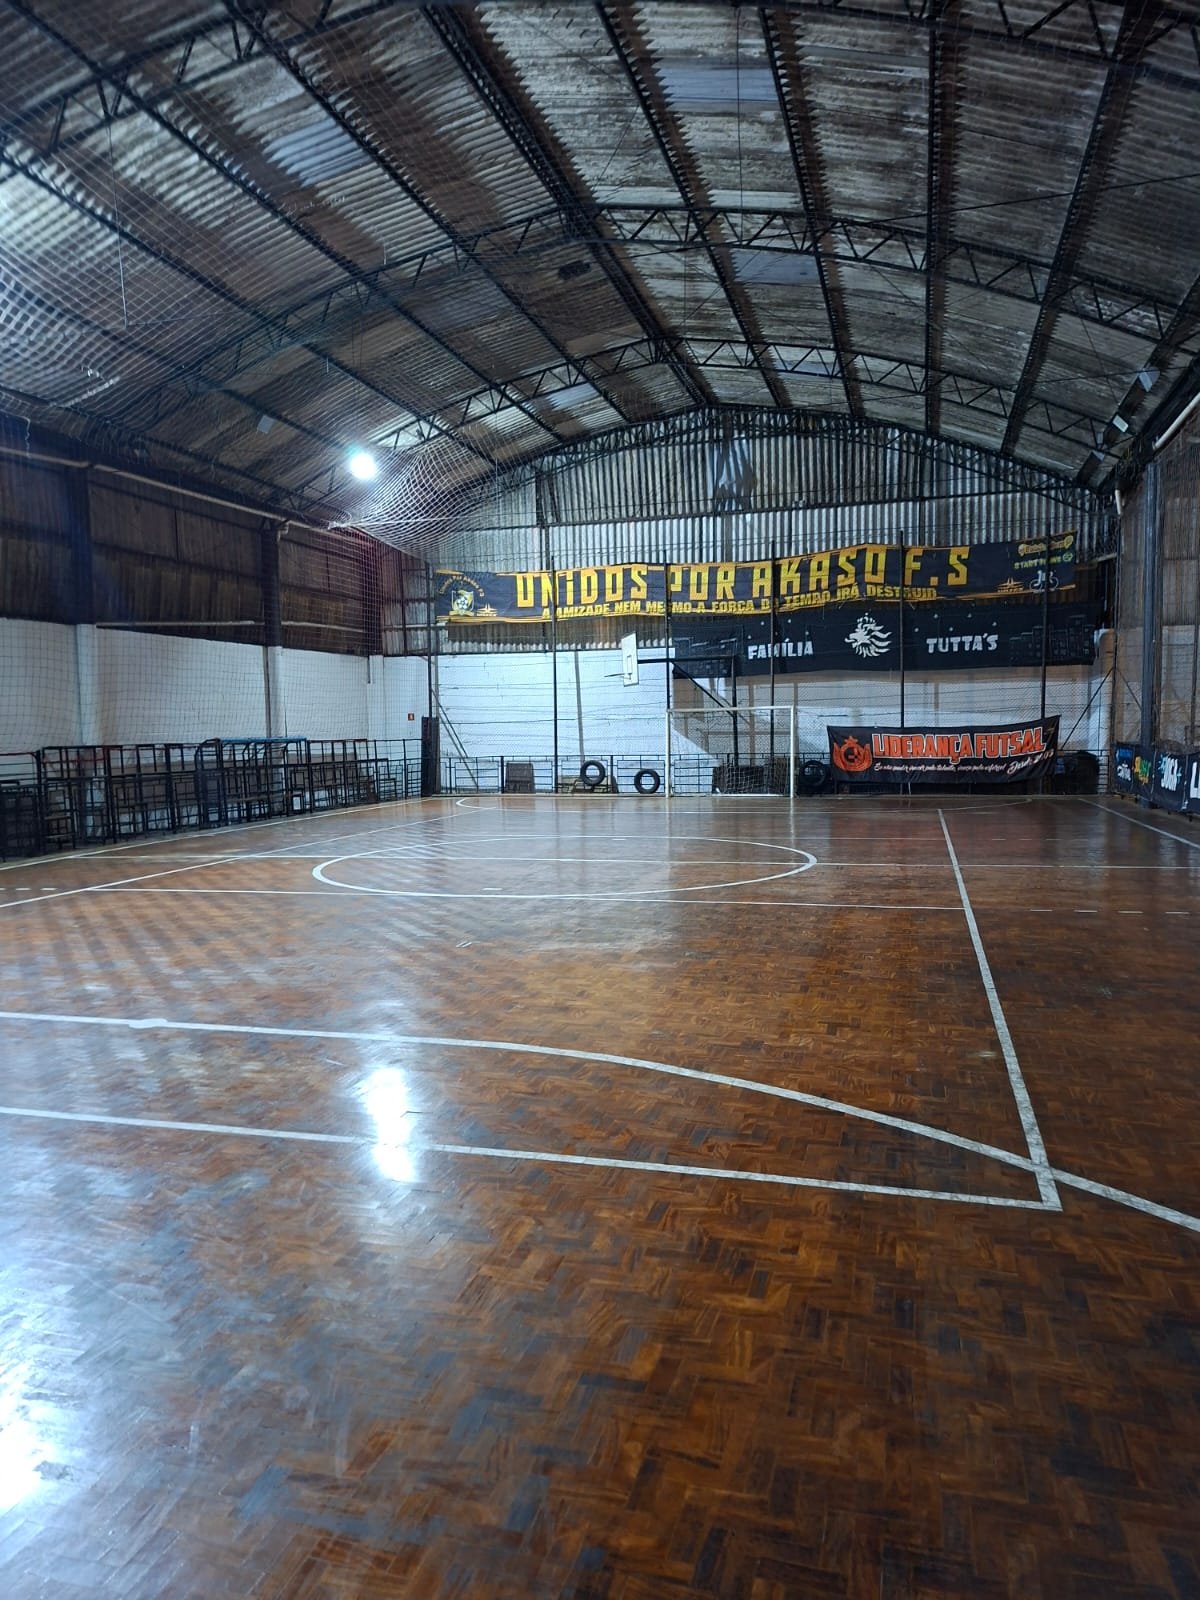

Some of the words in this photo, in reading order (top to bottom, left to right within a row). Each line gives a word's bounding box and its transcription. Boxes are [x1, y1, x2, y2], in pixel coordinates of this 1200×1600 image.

[666, 561, 736, 601] POR
[752, 543, 888, 598] AKASO
[904, 545, 970, 587] F.S
[541, 607, 551, 619] A
[556, 603, 610, 619] AMIZADE
[614, 600, 641, 613] NEM
[695, 601, 706, 613] A
[784, 591, 831, 608] TEMPO
[747, 637, 814, 660] FAMÍLIA
[871, 732, 975, 764] LIDERANÇA
[974, 727, 1047, 759] FUTSAL
